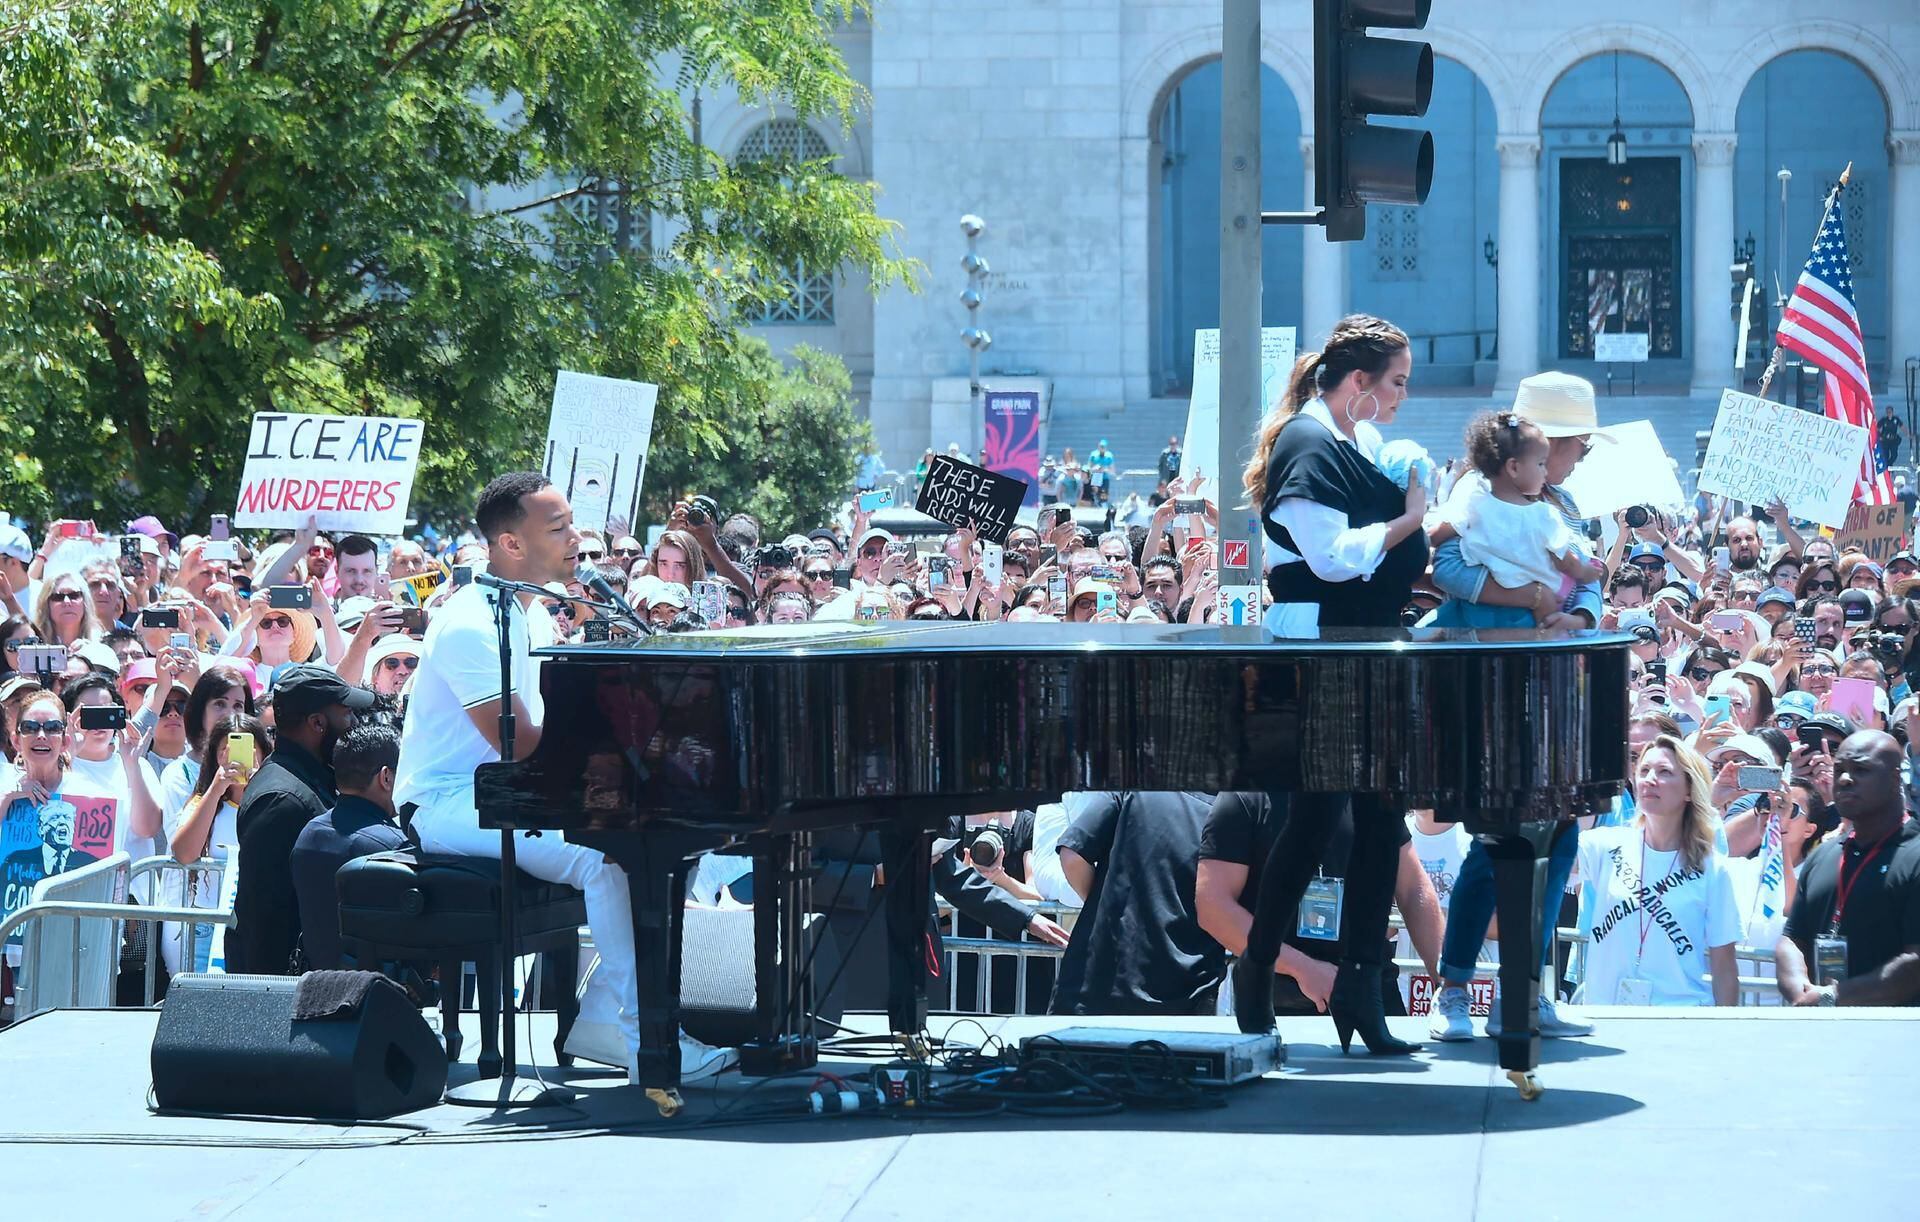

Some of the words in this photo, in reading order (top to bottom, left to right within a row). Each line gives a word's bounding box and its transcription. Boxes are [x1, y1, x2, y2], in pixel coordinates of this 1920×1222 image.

[567, 424, 633, 450] TRUMP
[1724, 393, 1765, 414] STOP
[1769, 405, 1859, 443] SEPARATING
[1728, 413, 1784, 439] FAMILIES
[1790, 430, 1853, 461] FLEEING
[348, 421, 418, 464] ARE
[1751, 434, 1814, 463] AMERICAN
[932, 457, 995, 497] THESE
[1728, 440, 1842, 488] INTERVENTION
[1745, 463, 1798, 490] MUSLIM
[1800, 481, 1830, 503] BAN
[237, 478, 401, 513] MURDERERS
[926, 478, 966, 508] KIDS
[968, 498, 1006, 526] WILL
[926, 499, 966, 527] RISE
[1876, 507, 1898, 526] OF
[6, 801, 34, 823] DOES
[77, 804, 113, 840] ASS
[7, 822, 33, 843] THIS
[7, 862, 43, 882] Make
[1592, 897, 1641, 944] RADICAL
[1653, 866, 1704, 896] WOMEN
[1632, 886, 1693, 956] RADICALES
[1413, 980, 1433, 1001] CA
[1467, 983, 1492, 1005] ATE
[1413, 1000, 1430, 1012] SIT
